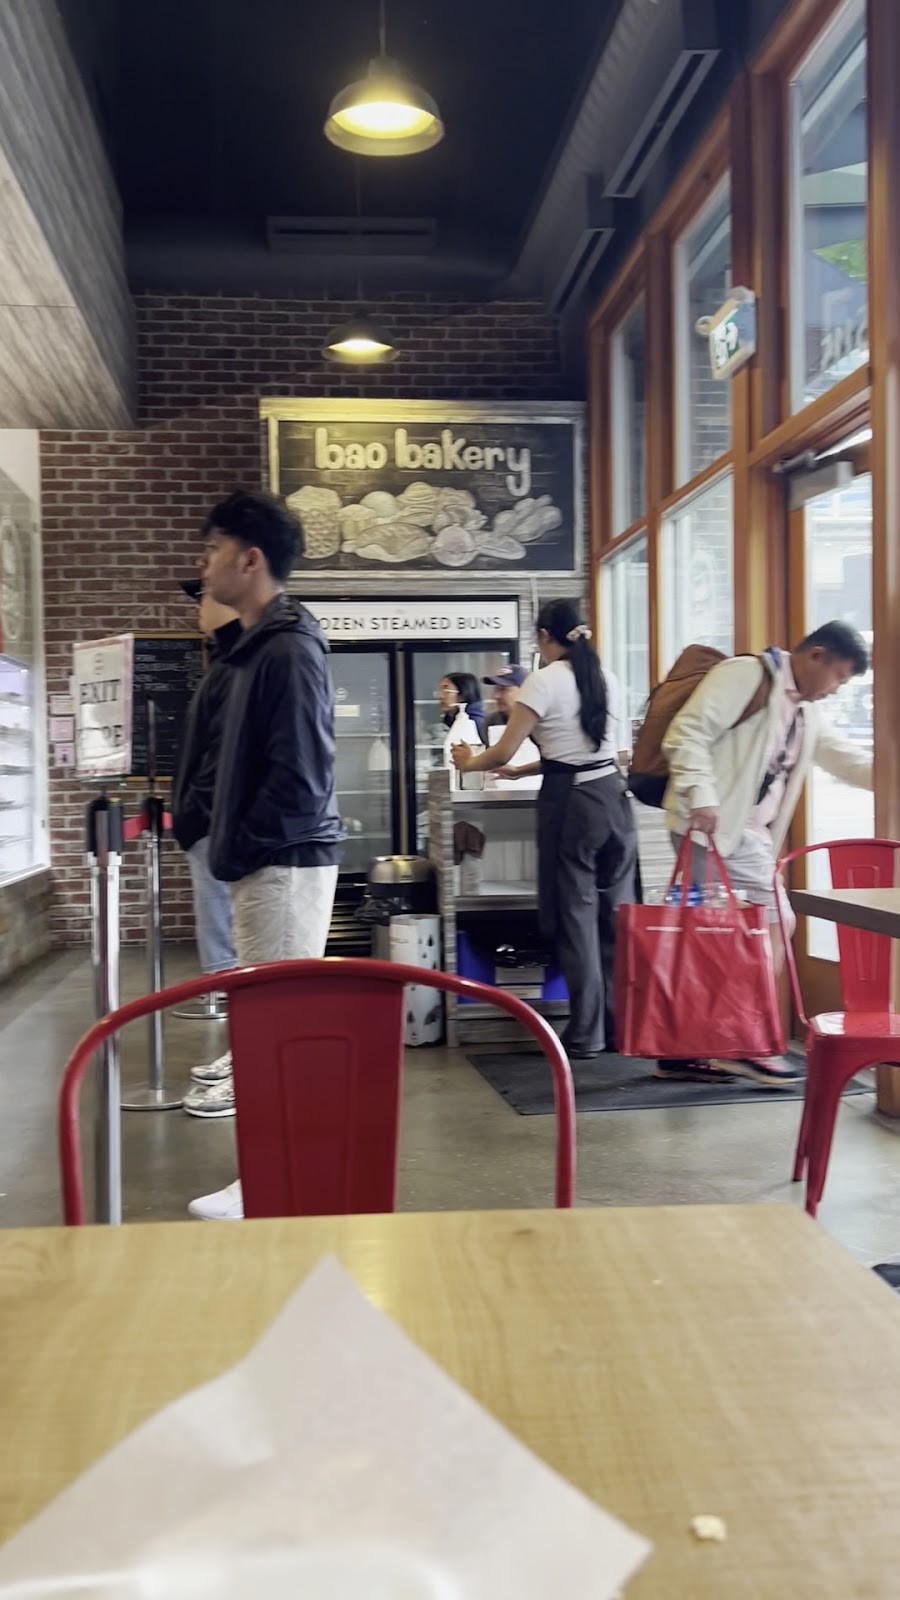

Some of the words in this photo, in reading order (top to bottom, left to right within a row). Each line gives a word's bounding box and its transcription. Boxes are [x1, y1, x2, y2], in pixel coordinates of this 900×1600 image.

[314, 426, 388, 469] bao
[394, 426, 531, 497] bakery
[318, 617, 365, 631] OZEN
[371, 617, 451, 631] STEAMED
[457, 616, 502, 631] BUNS
[79, 679, 121, 706] EXIT
